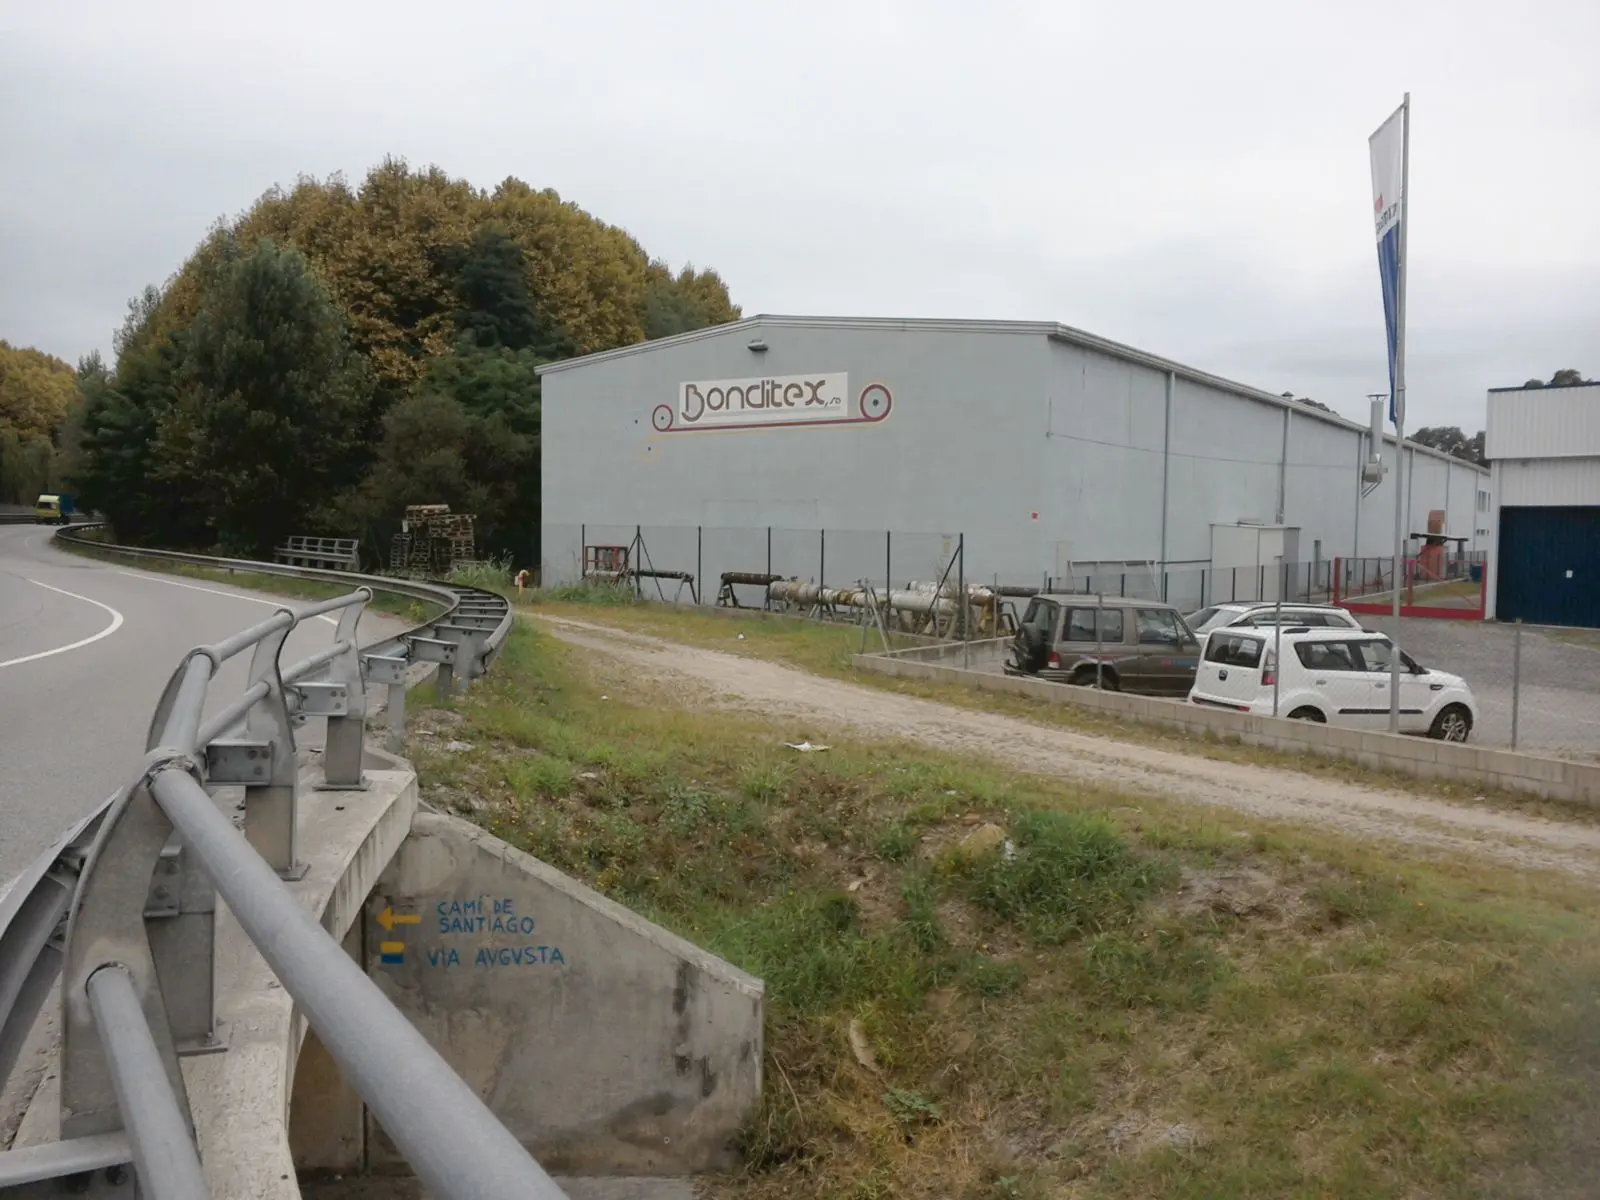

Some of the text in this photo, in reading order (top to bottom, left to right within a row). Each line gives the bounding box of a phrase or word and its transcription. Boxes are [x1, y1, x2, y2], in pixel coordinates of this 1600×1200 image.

[494, 900, 513, 914] DE
[439, 917, 535, 933] SANTIAGO
[428, 948, 460, 966] VIA
